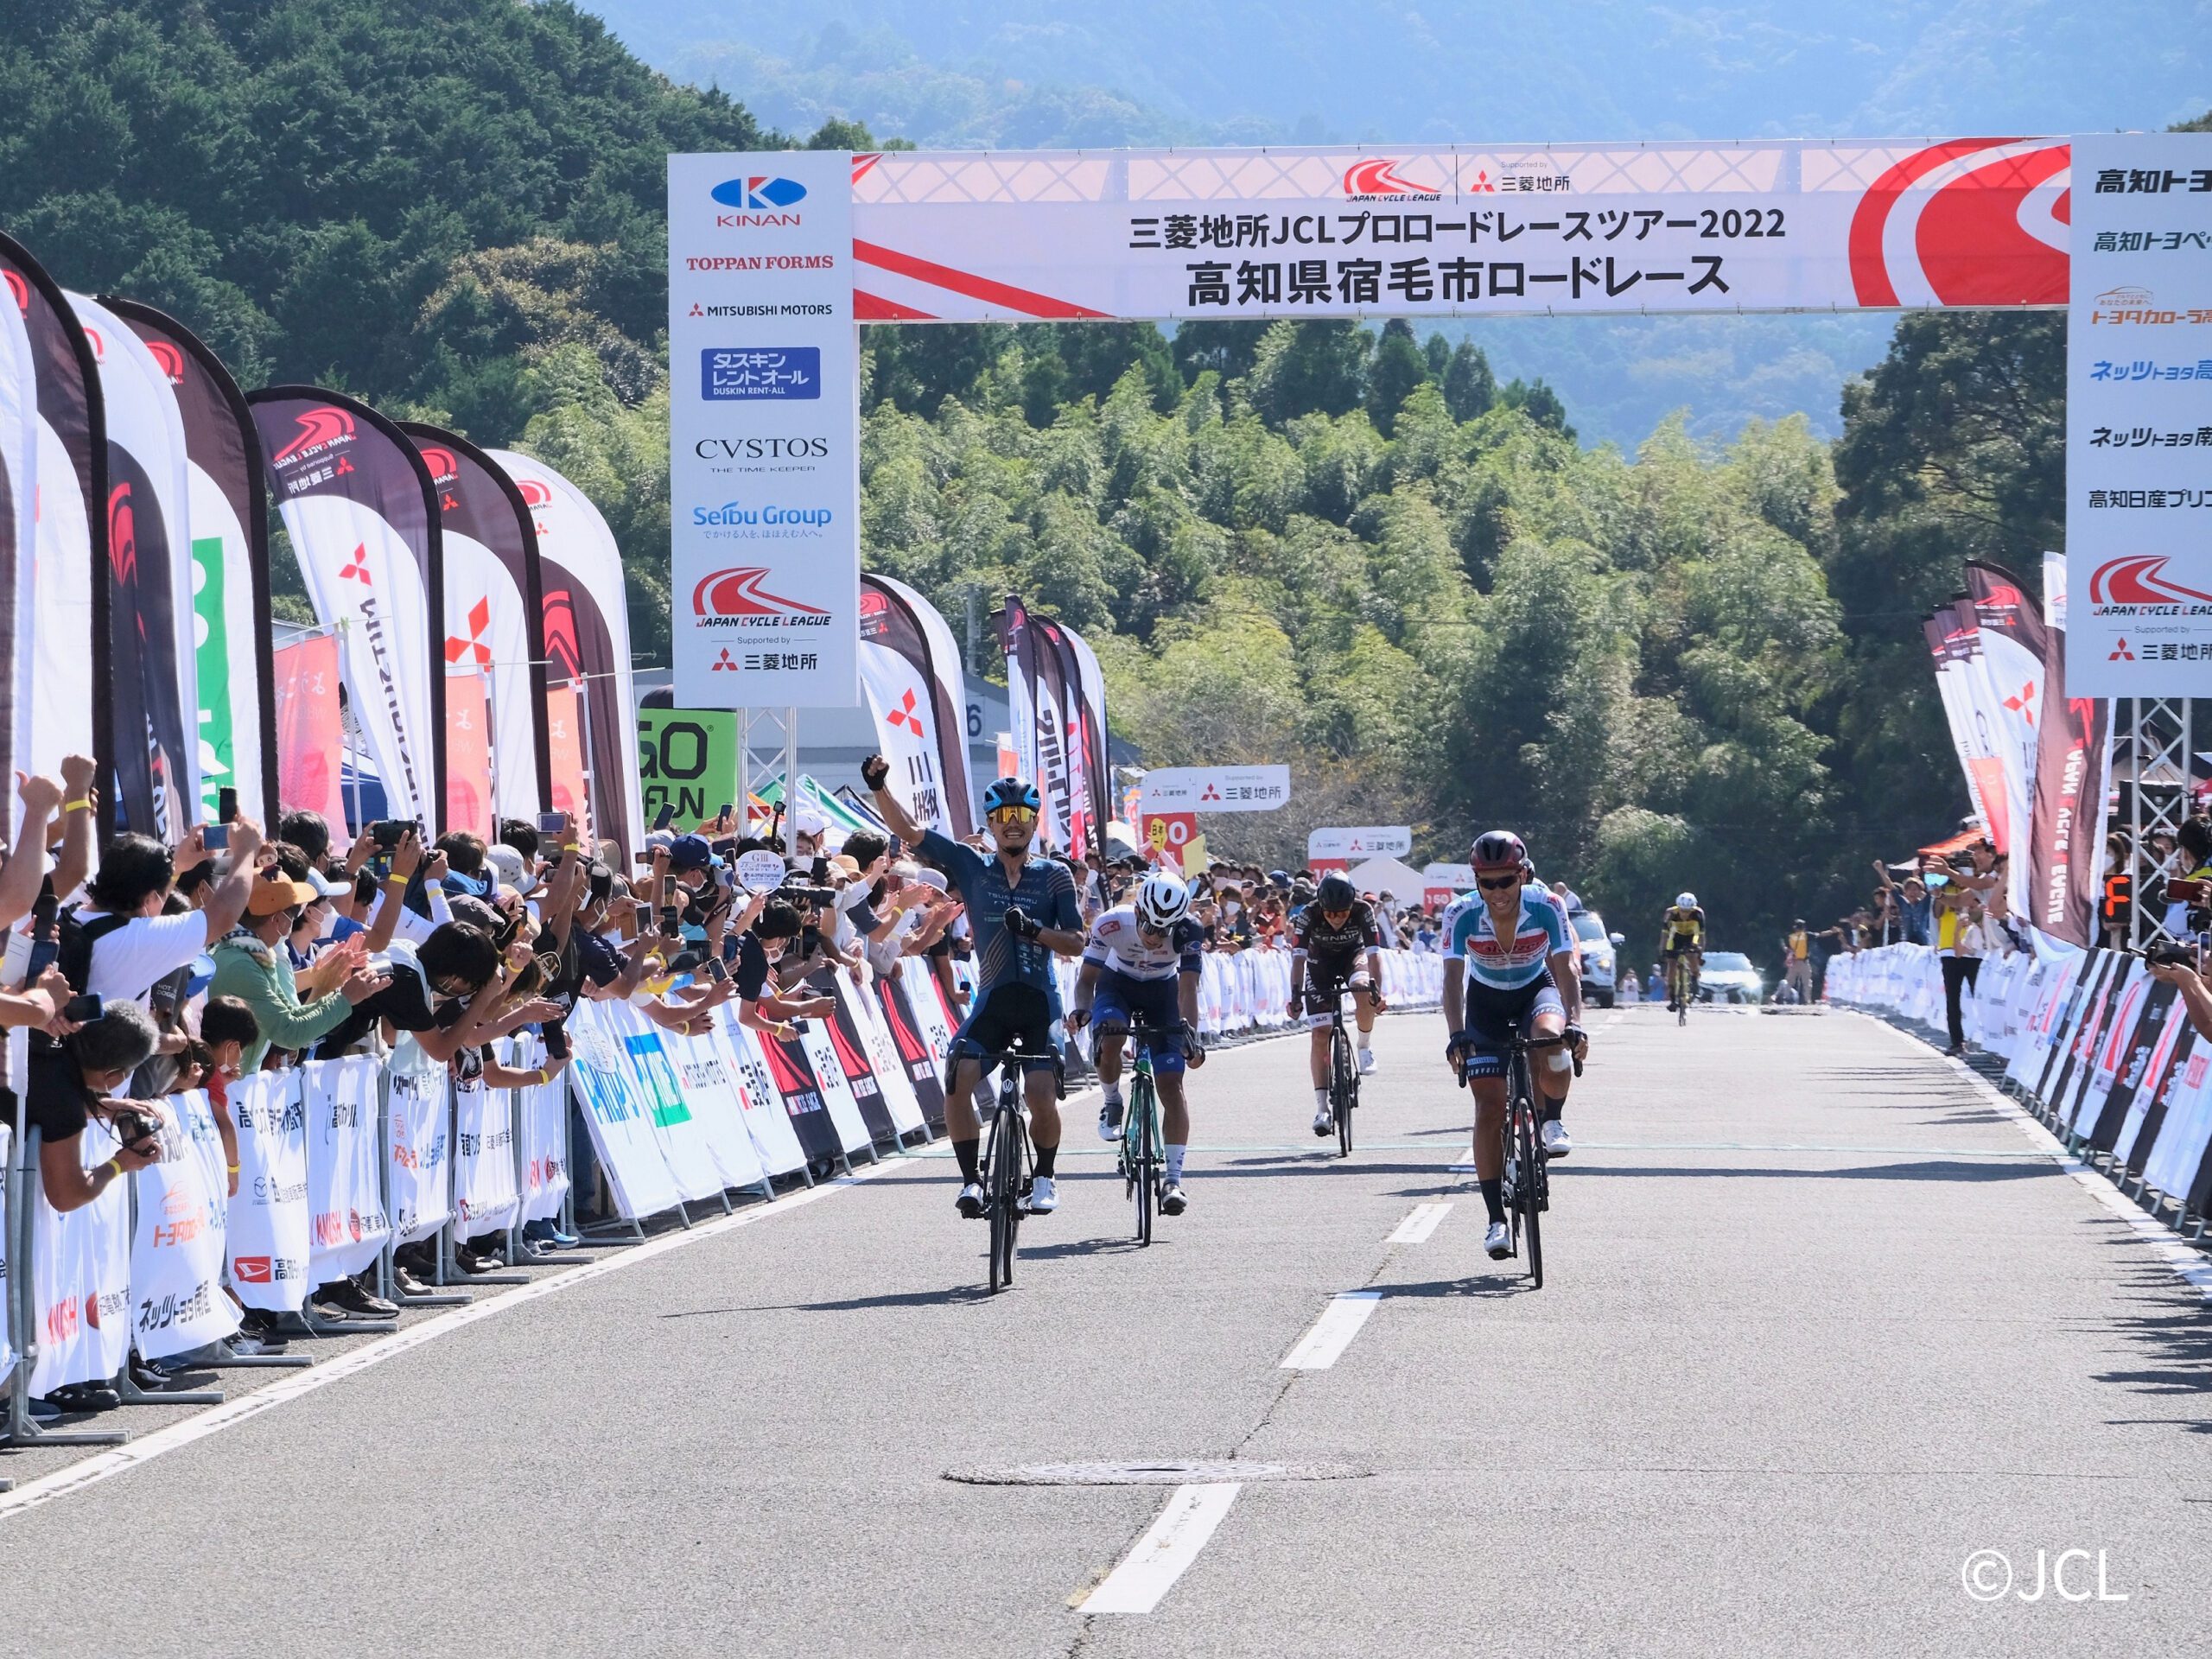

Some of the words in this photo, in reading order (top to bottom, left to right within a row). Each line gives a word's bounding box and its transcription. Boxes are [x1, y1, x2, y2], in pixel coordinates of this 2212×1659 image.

[1501, 175, 1570, 192] 三菱地所
[717, 214, 800, 226] KINAN
[1129, 208, 1786, 250] 三菱地所JCLプロロードレースツアー2022
[2094, 231, 2212, 252] 高知トヨペ
[686, 257, 761, 270] TOPPAN
[766, 256, 834, 270] FORMS
[1185, 256, 1730, 307] 高知県宿毛市ロードレース
[708, 305, 778, 316] MITSUBISHI
[781, 304, 832, 315] MOTORS
[713, 353, 785, 369] ダスキン
[713, 370, 810, 386] レントオール
[747, 386, 785, 395] RENT-ALL
[696, 437, 829, 459] CVSTOS
[693, 501, 758, 526] Seibu
[763, 505, 832, 527] Group
[2094, 606, 2137, 616] JAPAN
[2139, 606, 2180, 616] CYCLE
[696, 617, 740, 627] JAPAN
[741, 616, 779, 626] CYCLE
[782, 615, 832, 626] LEAGUE
[2134, 626, 2178, 635] Supported
[2181, 625, 2191, 635] by
[737, 635, 779, 645] Supported
[780, 635, 791, 645] by
[744, 653, 817, 671] 三菱地所
[1225, 786, 1281, 800] 三菱地所
[1426, 893, 1450, 905] 150
